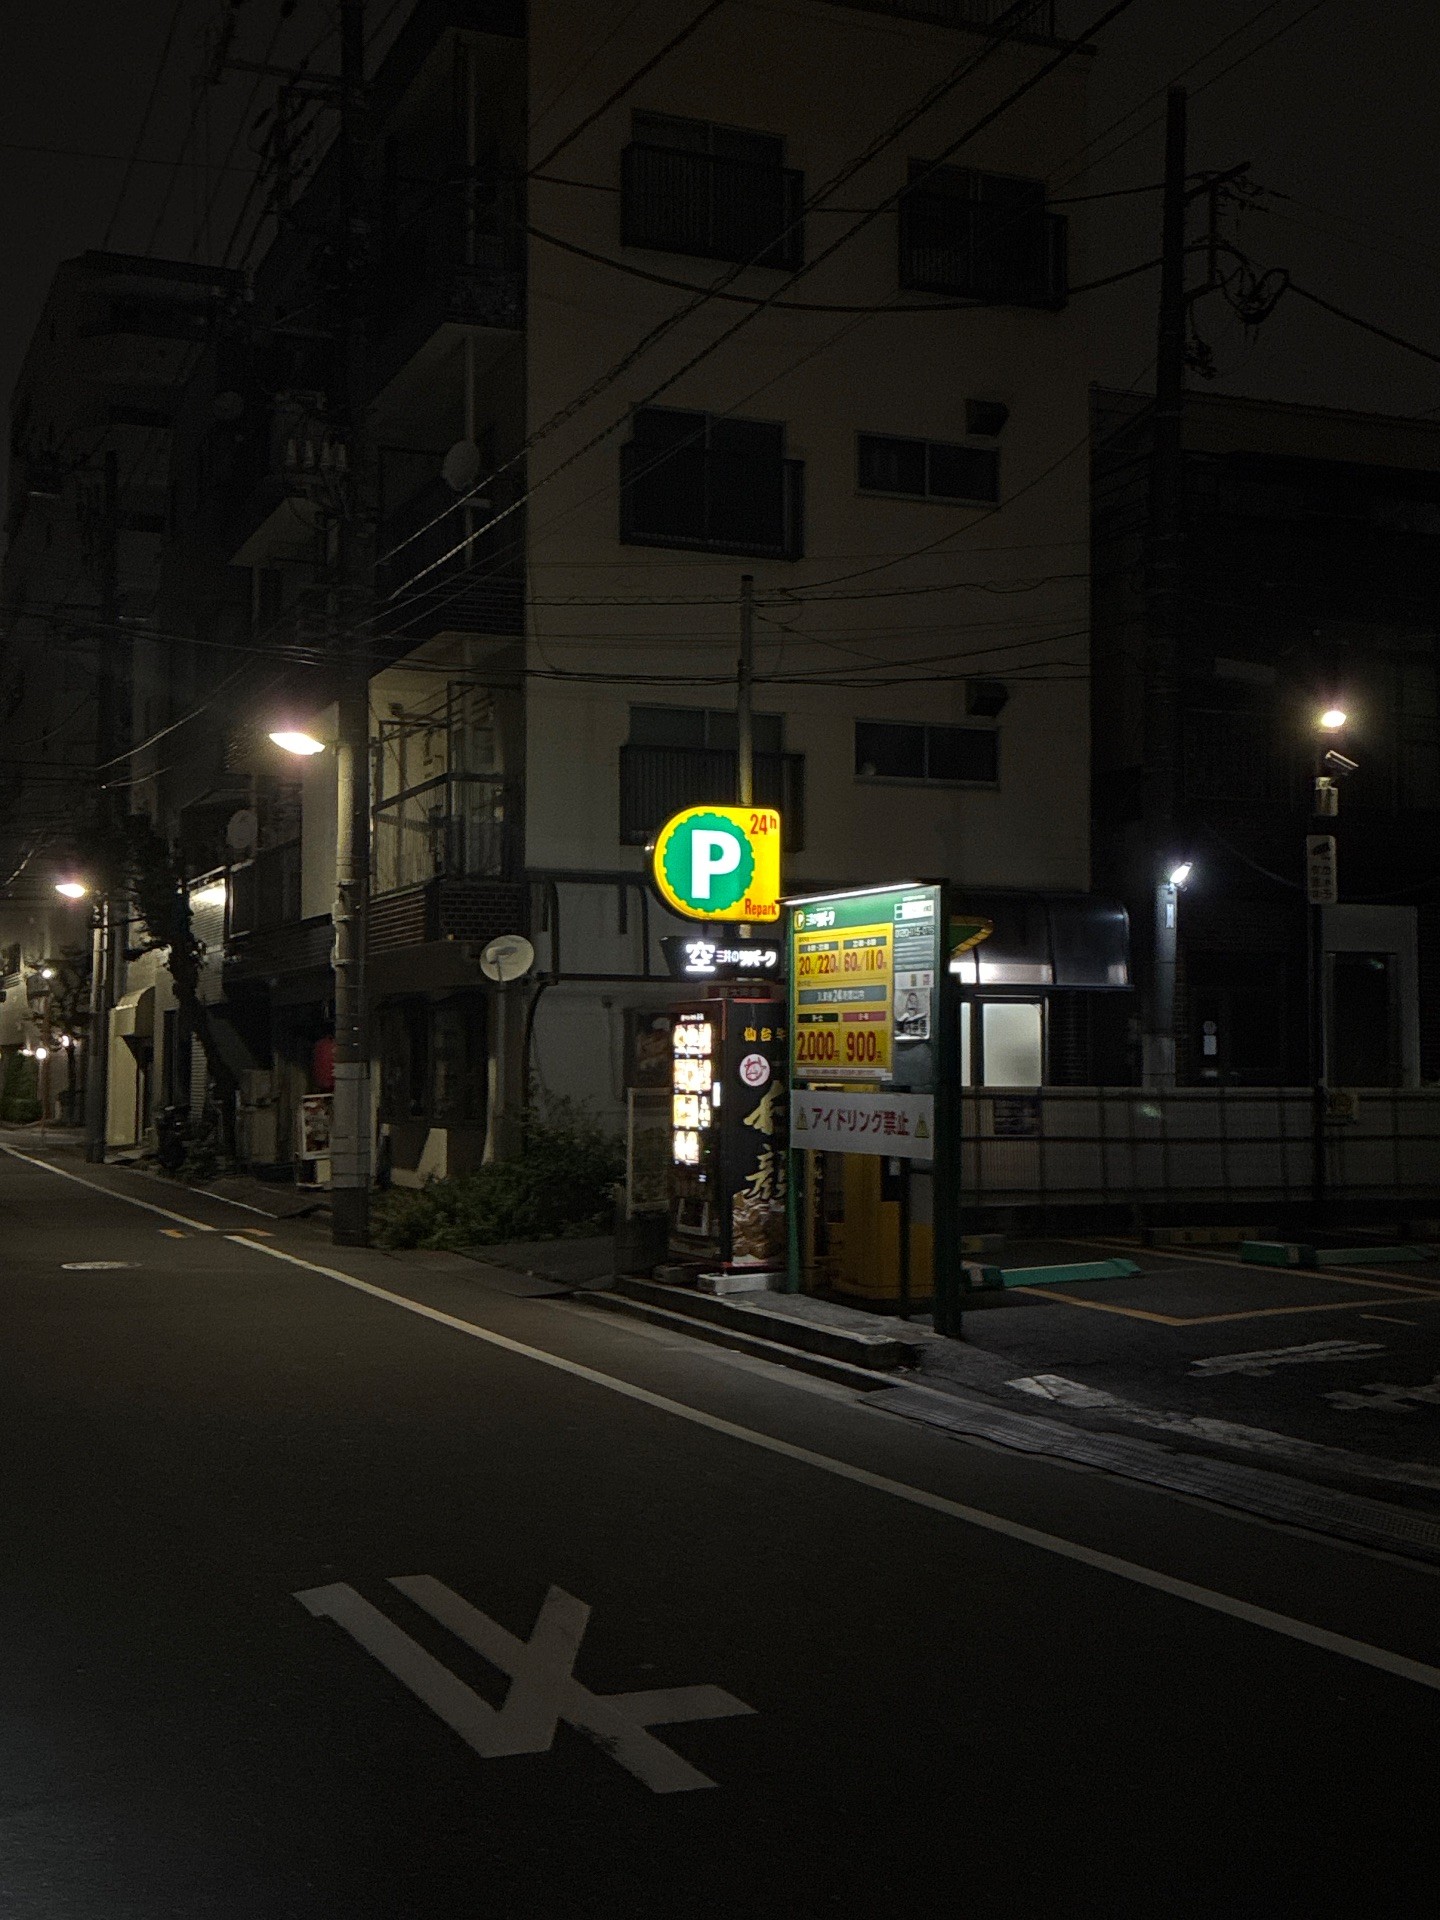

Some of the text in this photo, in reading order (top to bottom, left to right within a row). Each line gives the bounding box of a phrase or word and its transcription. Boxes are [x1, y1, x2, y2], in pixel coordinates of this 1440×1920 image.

[750, 813, 777, 835] 24h
[691, 829, 742, 899] P
[744, 898, 777, 918] Repark
[685, 940, 716, 972] 空
[811, 1106, 910, 1136] アイドリング禁止
